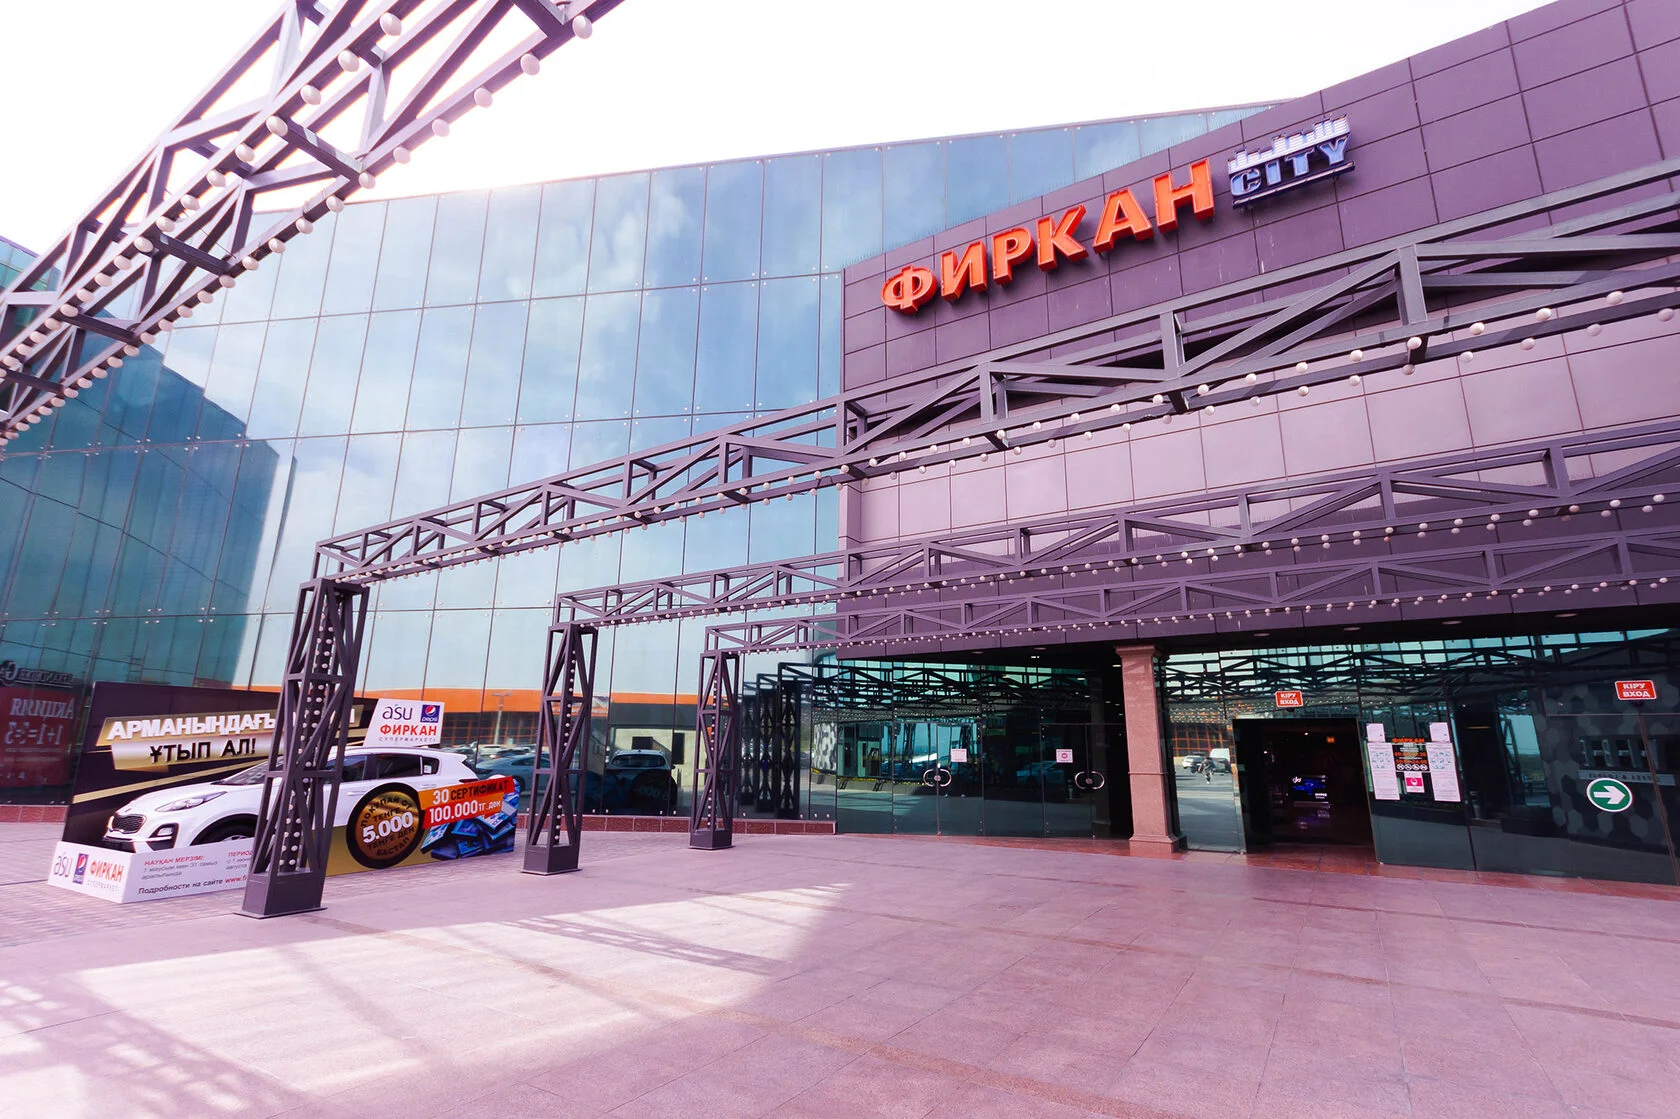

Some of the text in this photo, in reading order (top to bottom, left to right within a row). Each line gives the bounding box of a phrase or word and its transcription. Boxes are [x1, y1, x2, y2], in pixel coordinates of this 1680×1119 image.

[1230, 134, 1350, 197] CITY
[881, 158, 1215, 314] ФИРКАН
[1622, 690, 1651, 698] ВХОД
[379, 724, 437, 736] ФИРКАН
[150, 738, 256, 763] ҰТЫП АЛ!
[432, 780, 509, 805] 30 СЕРТИФИКАТ
[373, 808, 401, 822] ТЕНГЕ
[429, 800, 478, 824] 100.000
[363, 811, 414, 843] 5.000
[90, 861, 125, 882] ФИРКАН
[138, 883, 190, 895] Подробности
[203, 879, 223, 888] сайте
